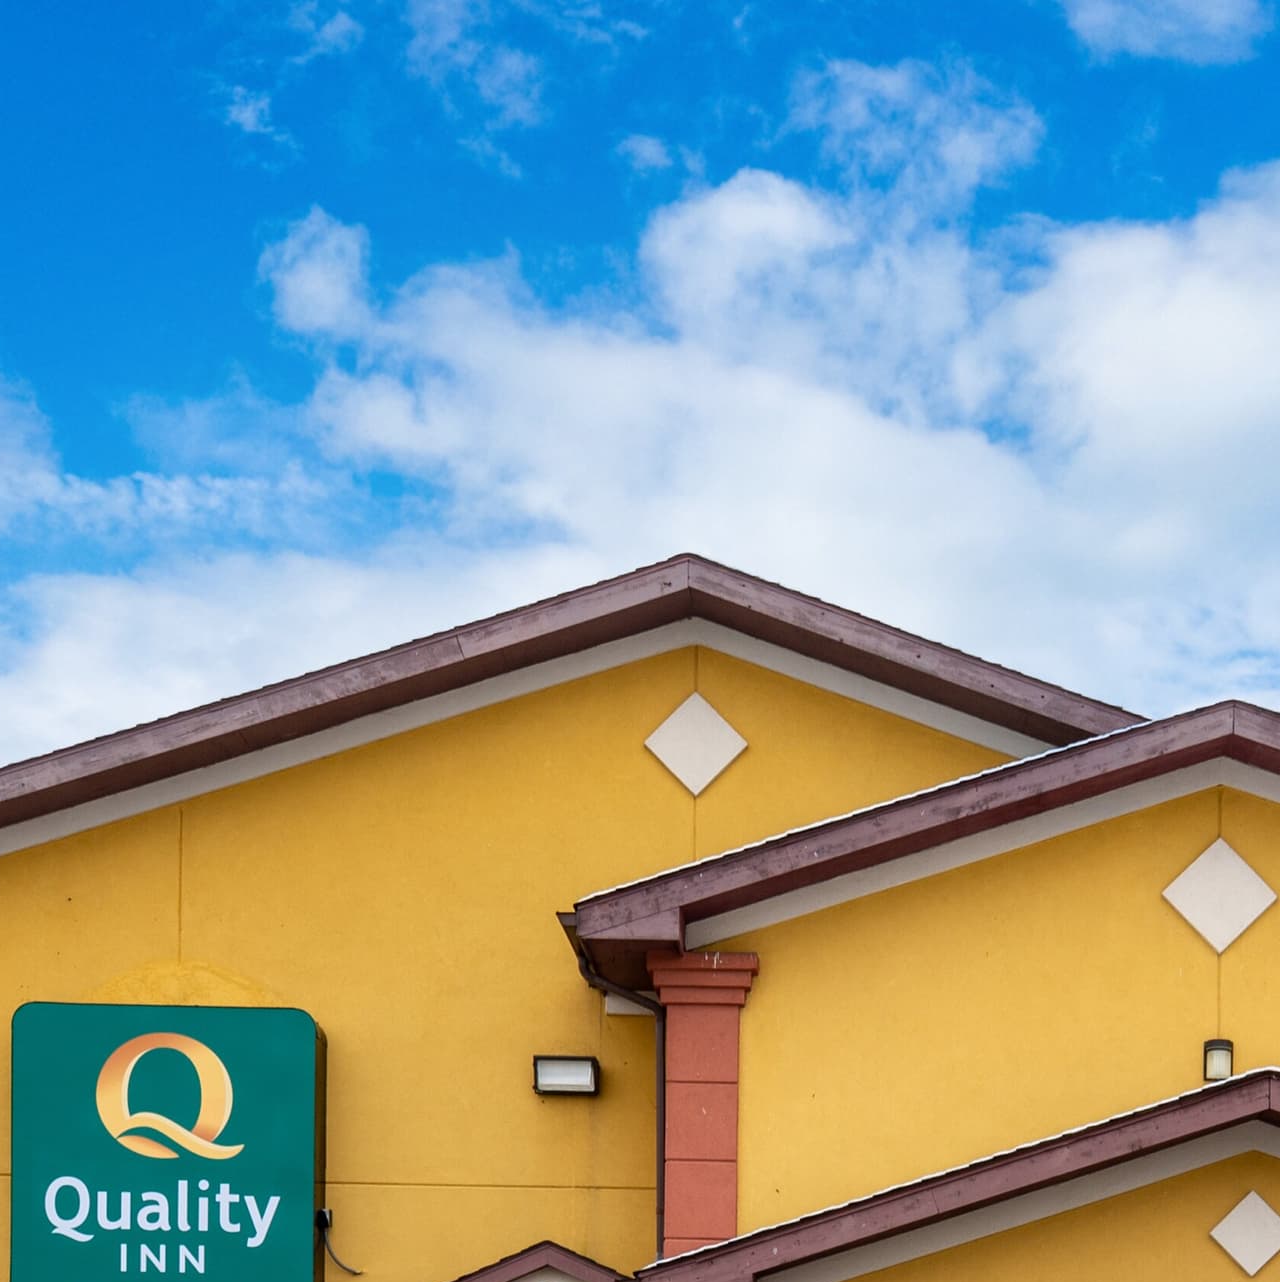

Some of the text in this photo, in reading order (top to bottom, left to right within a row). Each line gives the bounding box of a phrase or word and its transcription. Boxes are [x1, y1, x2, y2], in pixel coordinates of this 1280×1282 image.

[96, 1032, 245, 1160] Q
[44, 1175, 281, 1248] Quality
[120, 1243, 205, 1274] INN
